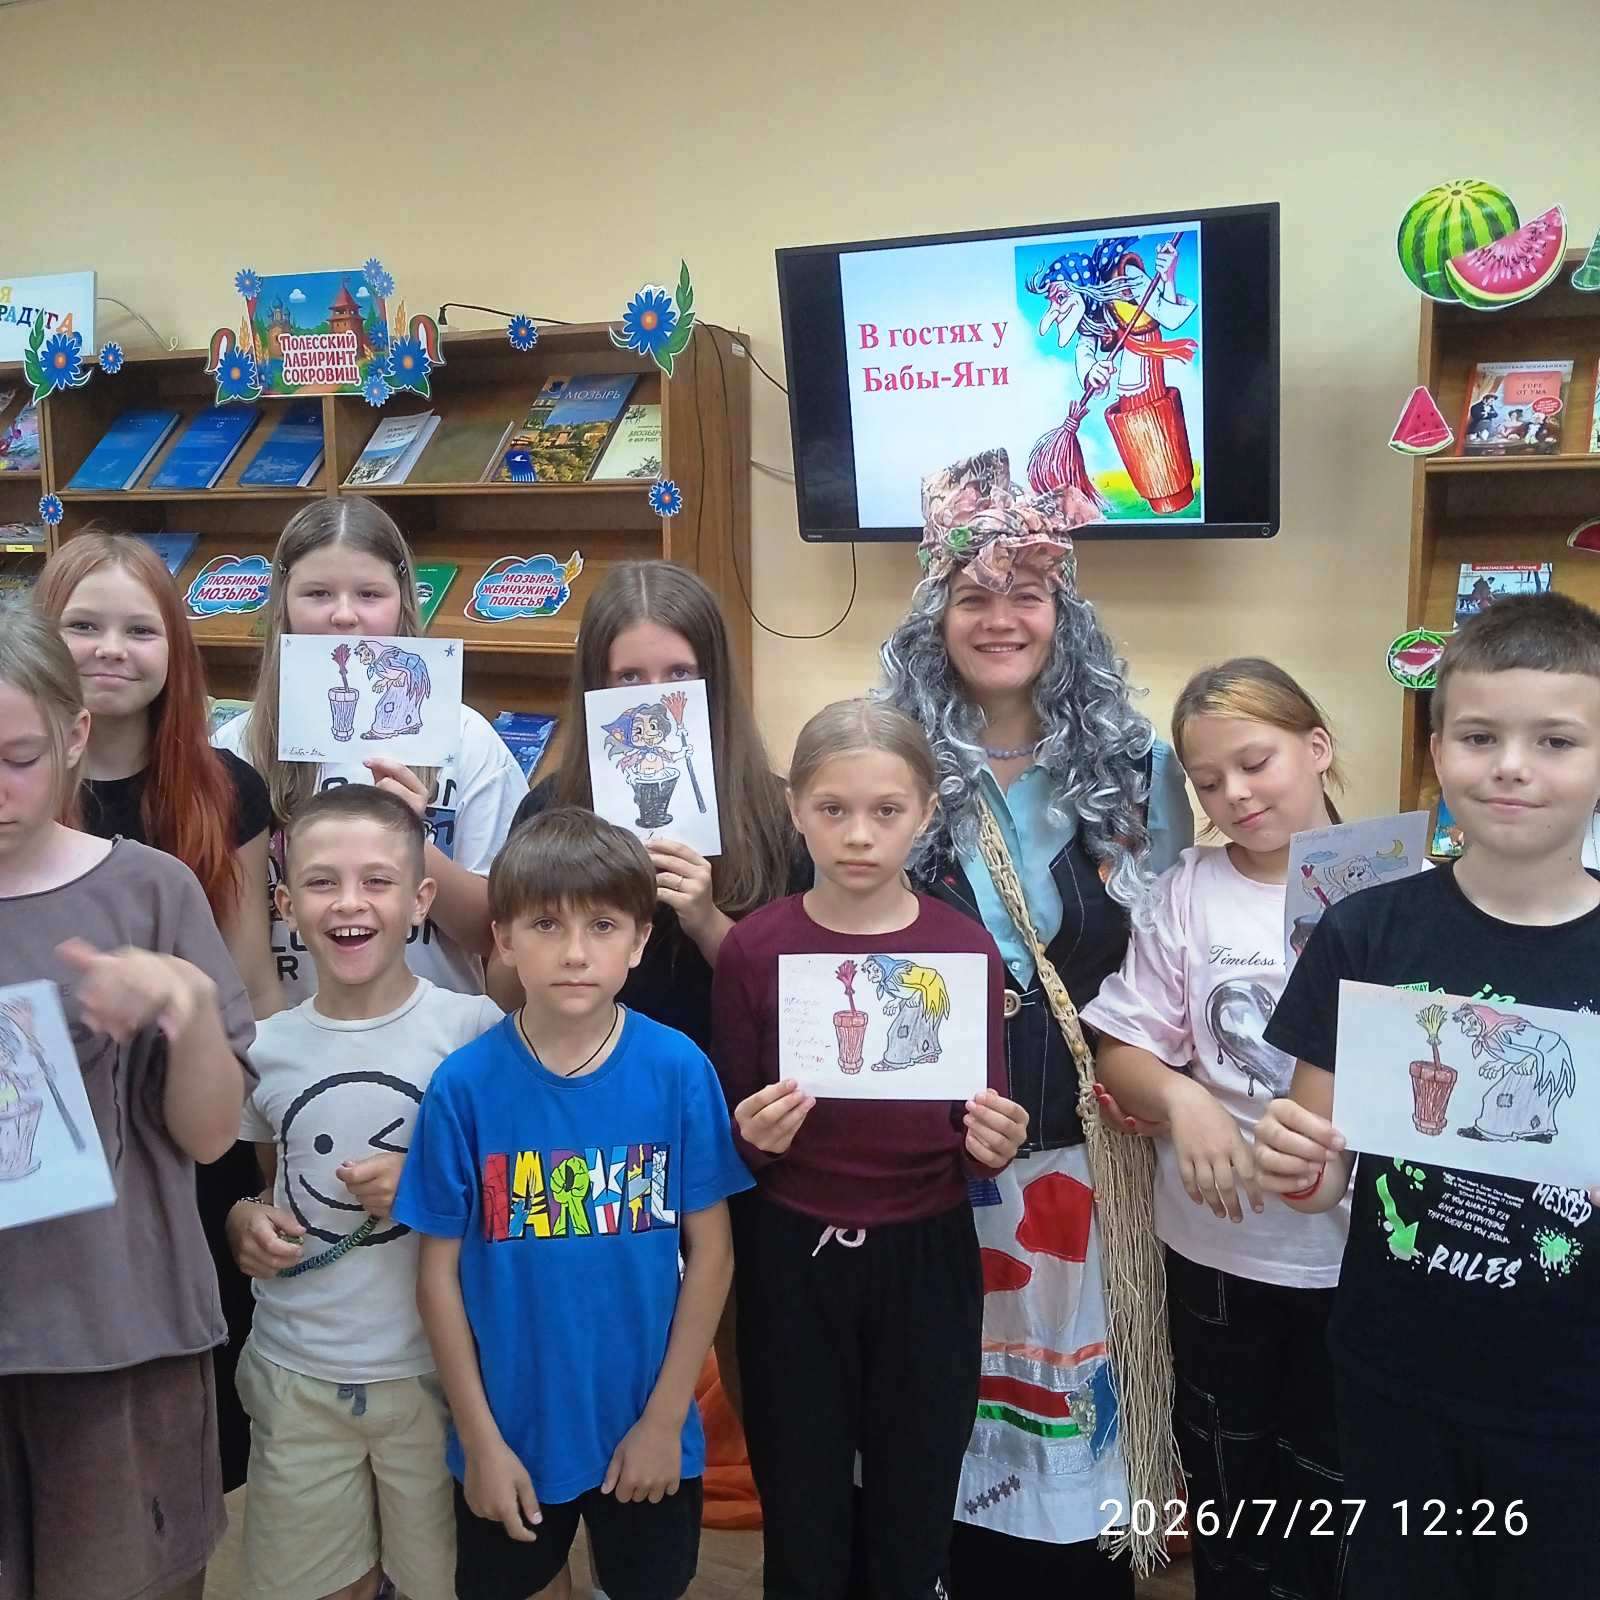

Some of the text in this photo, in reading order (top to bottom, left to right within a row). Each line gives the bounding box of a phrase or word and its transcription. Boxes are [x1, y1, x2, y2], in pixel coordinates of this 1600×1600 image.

[0, 305, 73, 337] РАДГА
[858, 321, 1008, 349] В гостях у
[284, 350, 355, 368] ЛАБИРИНТ
[283, 366, 360, 384] СОКРОВИЩ
[862, 361, 1009, 392] Бабы-Яги
[565, 390, 621, 400] МОЗЫРЬ
[195, 587, 259, 601] МОЗЫРЬ
[481, 584, 560, 597] ЖЕМЧУЖИНА
[489, 596, 544, 607] ПОЛЕСЬЯ
[1208, 945, 1275, 966] Timeless
[1451, 1195, 1464, 1206] YOU
[1465, 1200, 1487, 1212] WANT
[1487, 1207, 1495, 1215] TO
[1427, 1209, 1445, 1220] THAT
[1473, 1225, 1487, 1237] YOU
[1438, 1202, 1454, 1213] GIVE
[1465, 1212, 1506, 1231] EVERYTHING
[1427, 1244, 1522, 1288] RULES
